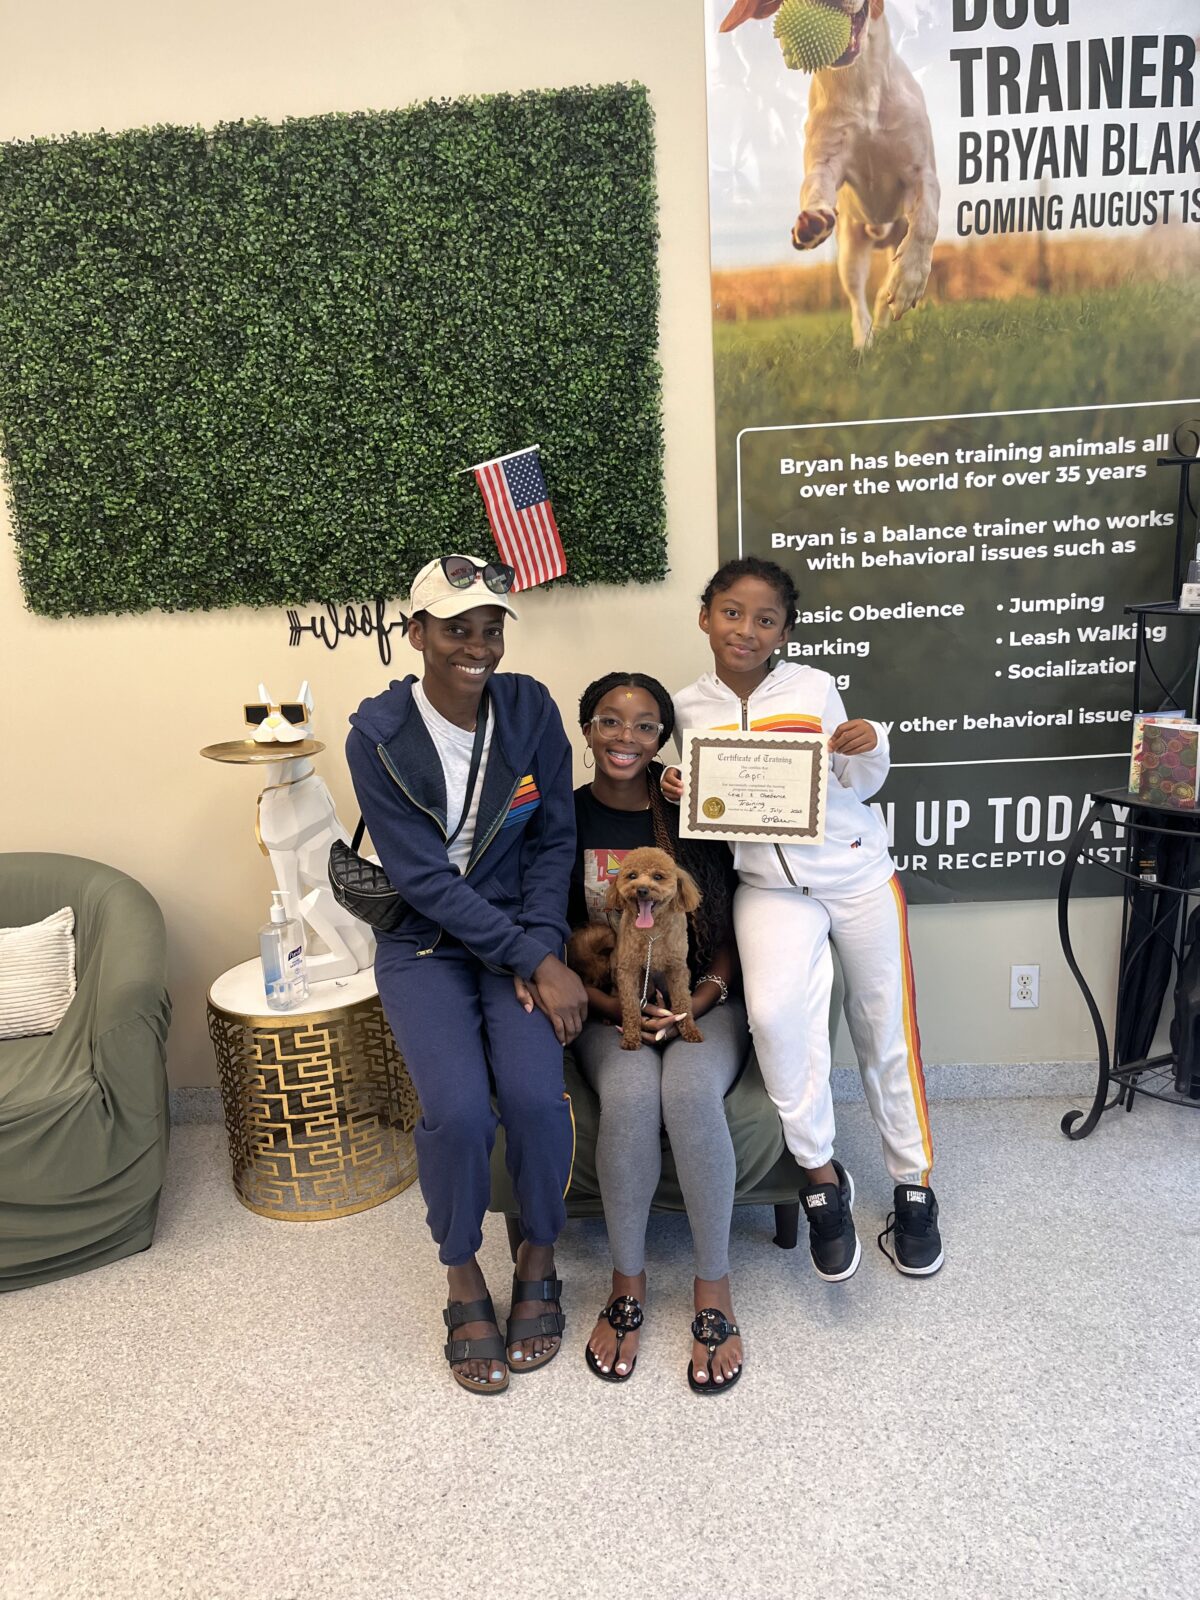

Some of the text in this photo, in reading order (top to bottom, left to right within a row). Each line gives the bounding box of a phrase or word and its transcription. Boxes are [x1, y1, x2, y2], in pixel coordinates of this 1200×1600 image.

[950, 34, 1196, 117] TRAINER
[958, 124, 1089, 185] BRYAN
[957, 195, 1064, 236] COMING
[1070, 190, 1175, 229] AUGUST
[780, 433, 1169, 477] Bryan has been training animals all
[799, 464, 1147, 498] over the world for over 35 years
[771, 510, 1174, 551] Bryan is a balance trainer who works
[806, 538, 1136, 571] with behavioral issues such as
[795, 601, 965, 624] asic Obedience
[1009, 592, 1105, 614] Jumping
[787, 638, 870, 657] Barking
[1009, 628, 1071, 647] Leash
[899, 716, 958, 733] other
[963, 709, 1074, 730] behavioral
[1079, 707, 1143, 724] issue
[718, 753, 792, 764] Certificate of Training
[739, 769, 766, 782] Capri
[915, 799, 970, 847] UP
[893, 854, 927, 871] UR
